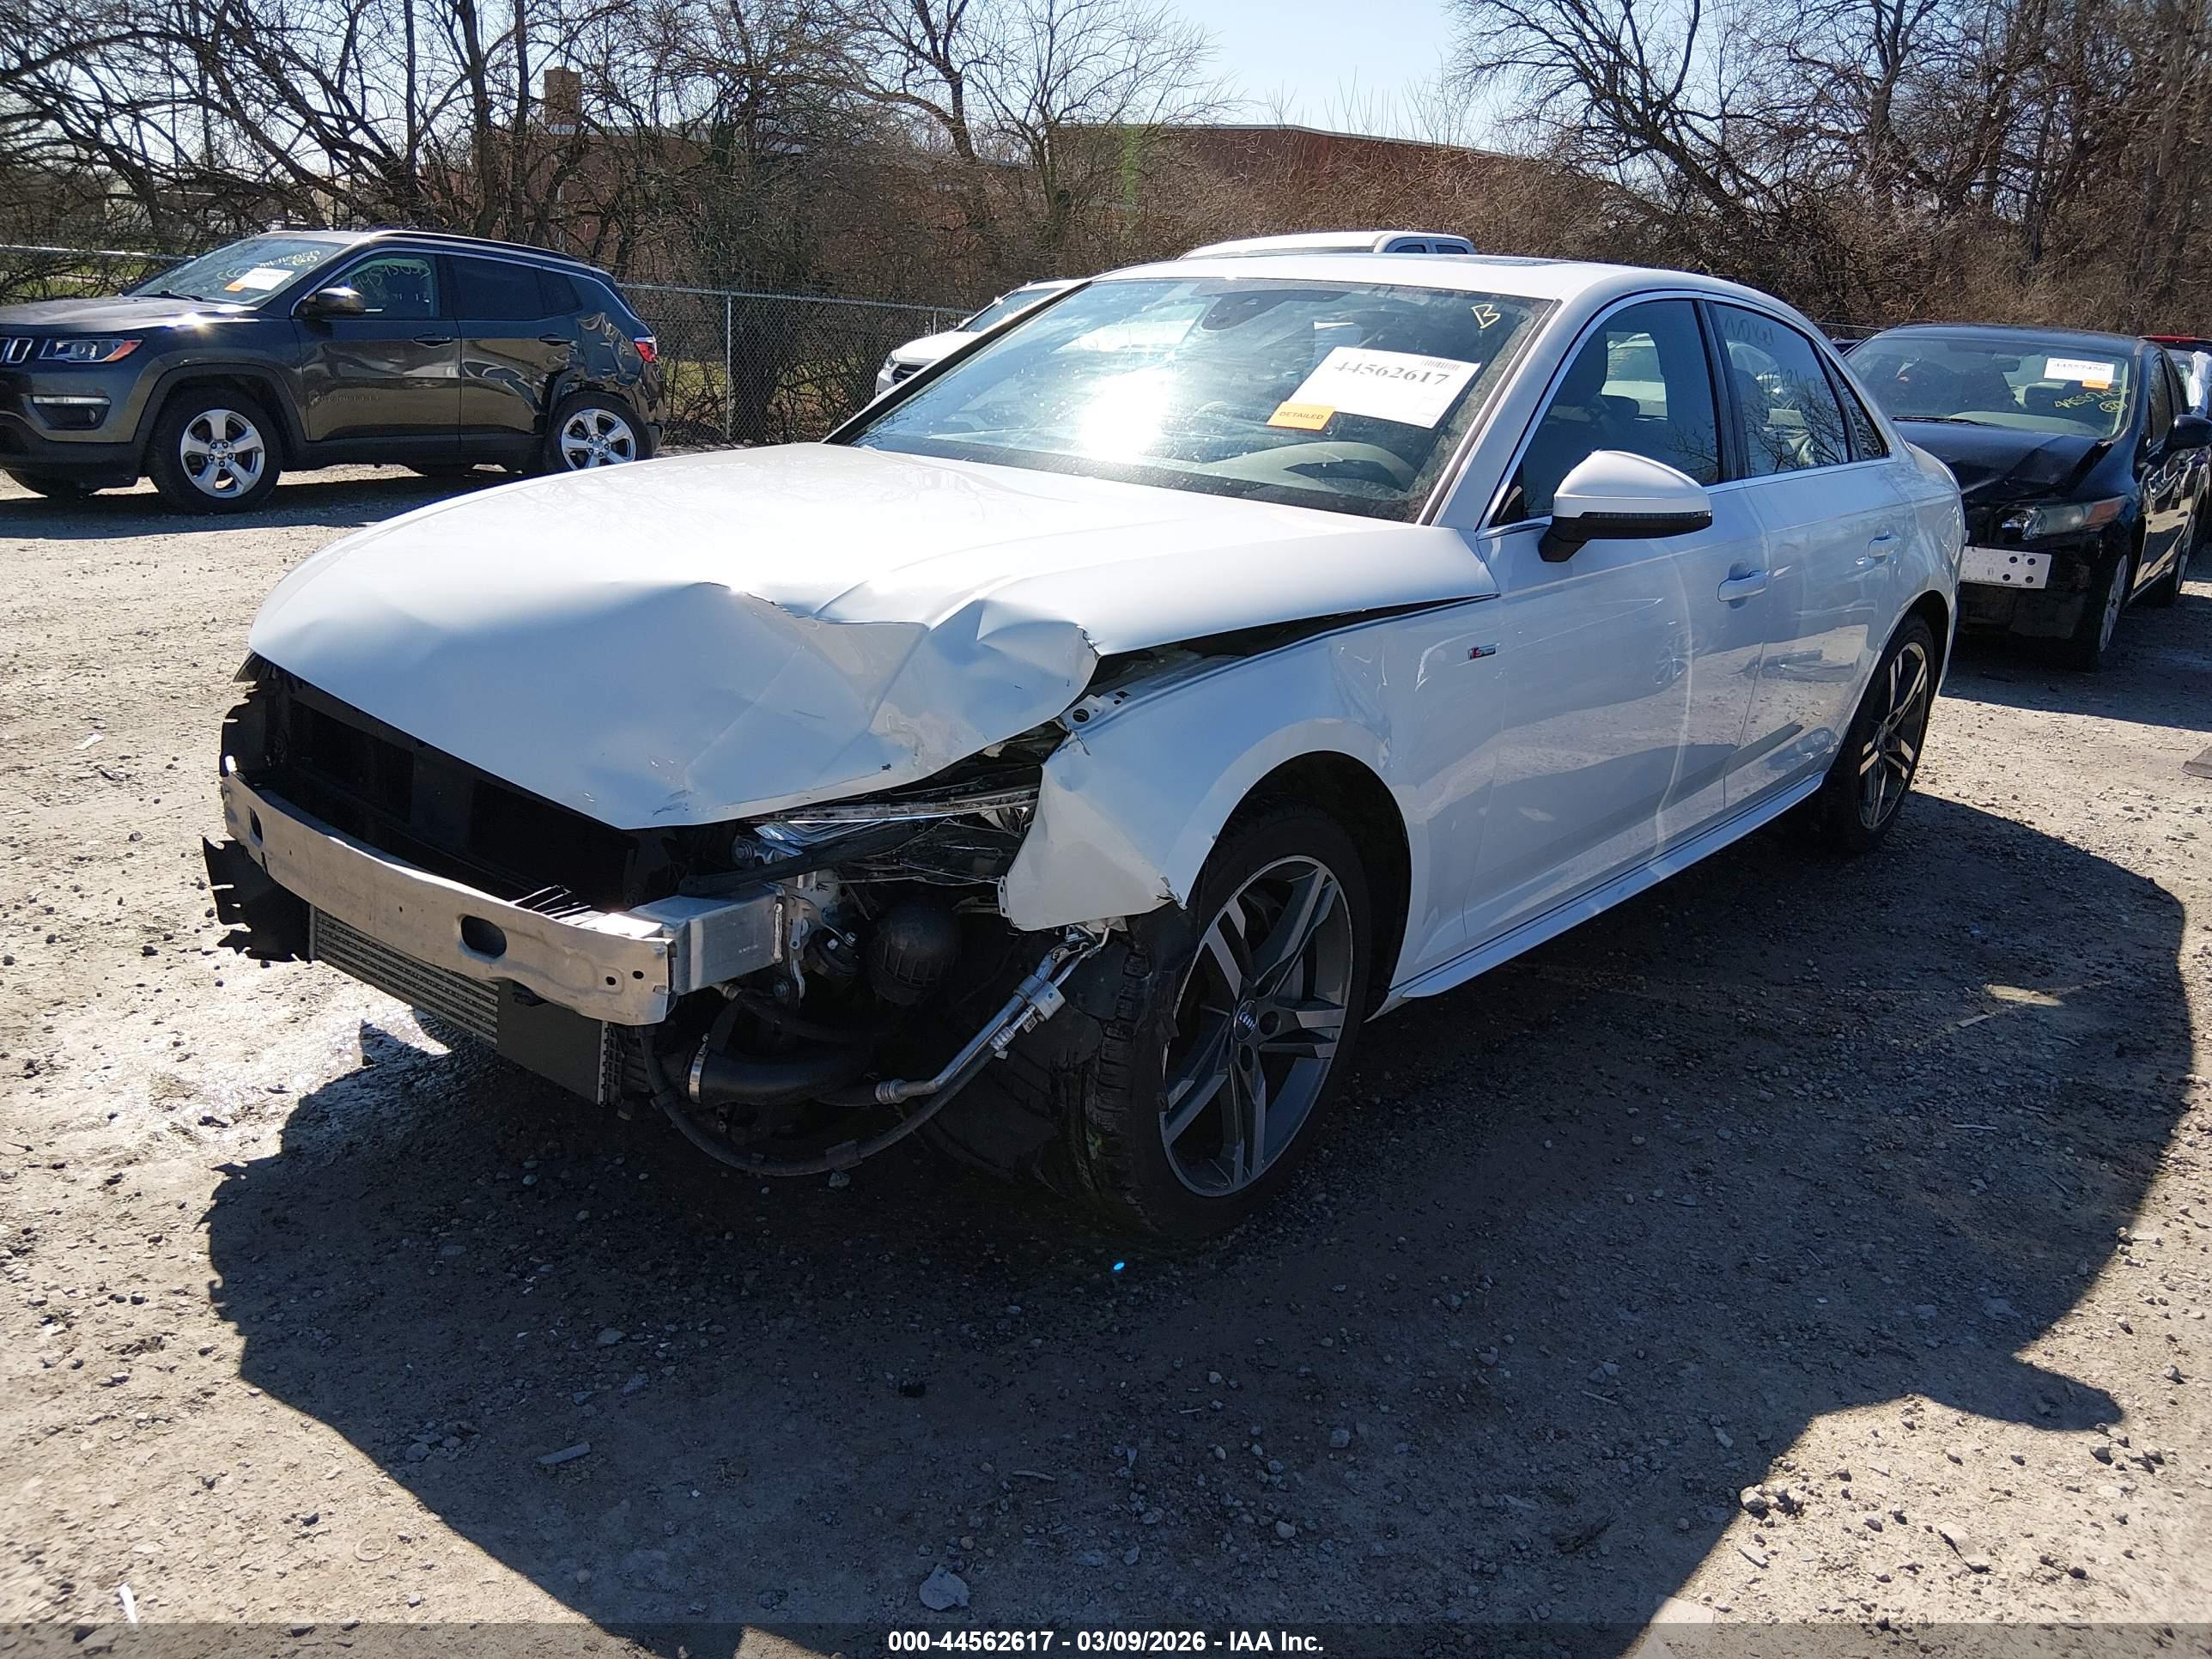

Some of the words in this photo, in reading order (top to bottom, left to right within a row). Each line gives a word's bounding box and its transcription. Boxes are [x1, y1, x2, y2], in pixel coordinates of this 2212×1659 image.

[1471, 304, 1500, 329] B
[1334, 362, 1449, 385] 44562617
[1279, 411, 1324, 420] DETAILED
